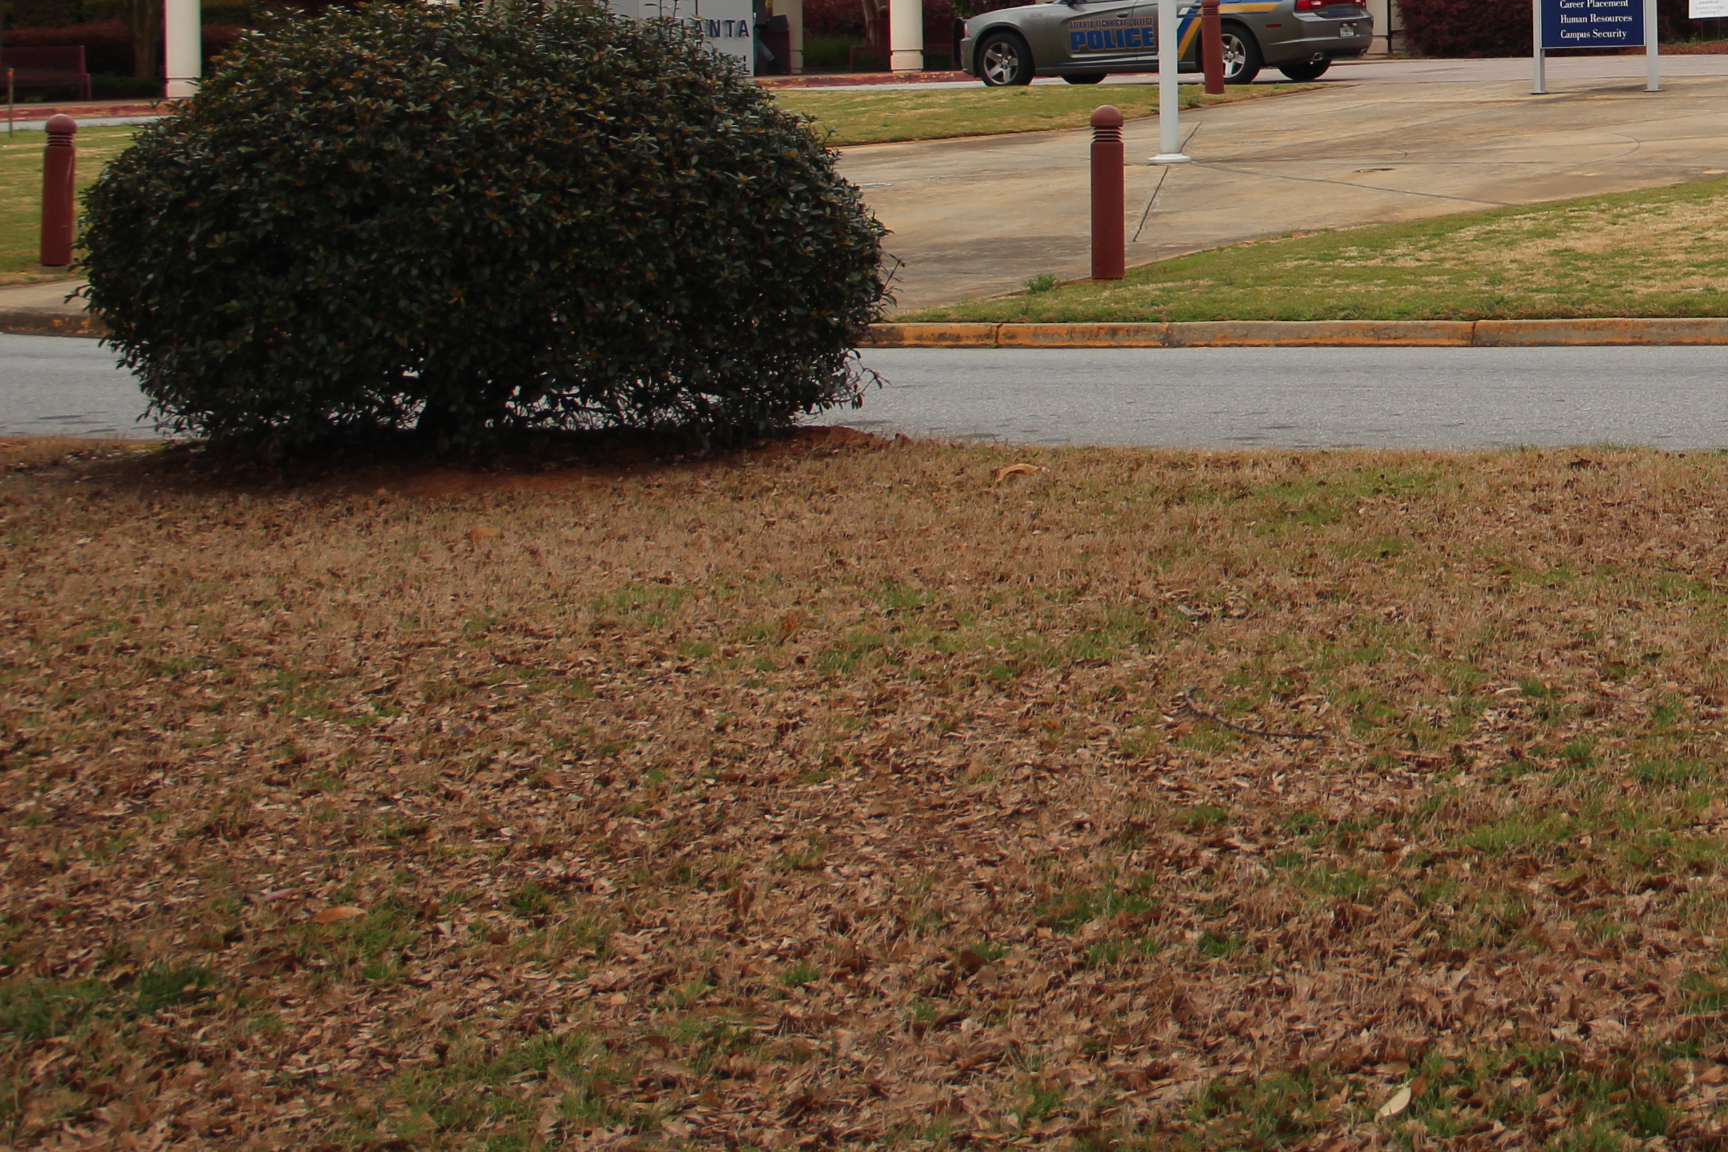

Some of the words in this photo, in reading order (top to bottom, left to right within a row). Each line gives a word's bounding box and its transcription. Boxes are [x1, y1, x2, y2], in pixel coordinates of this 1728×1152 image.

[1560, 0, 1584, 8] Career
[1560, 14, 1587, 24] Human
[1590, 13, 1633, 23] Resources
[1070, 27, 1155, 50] POLICE
[1560, 29, 1590, 41] Campus
[1592, 28, 1627, 40] Security
